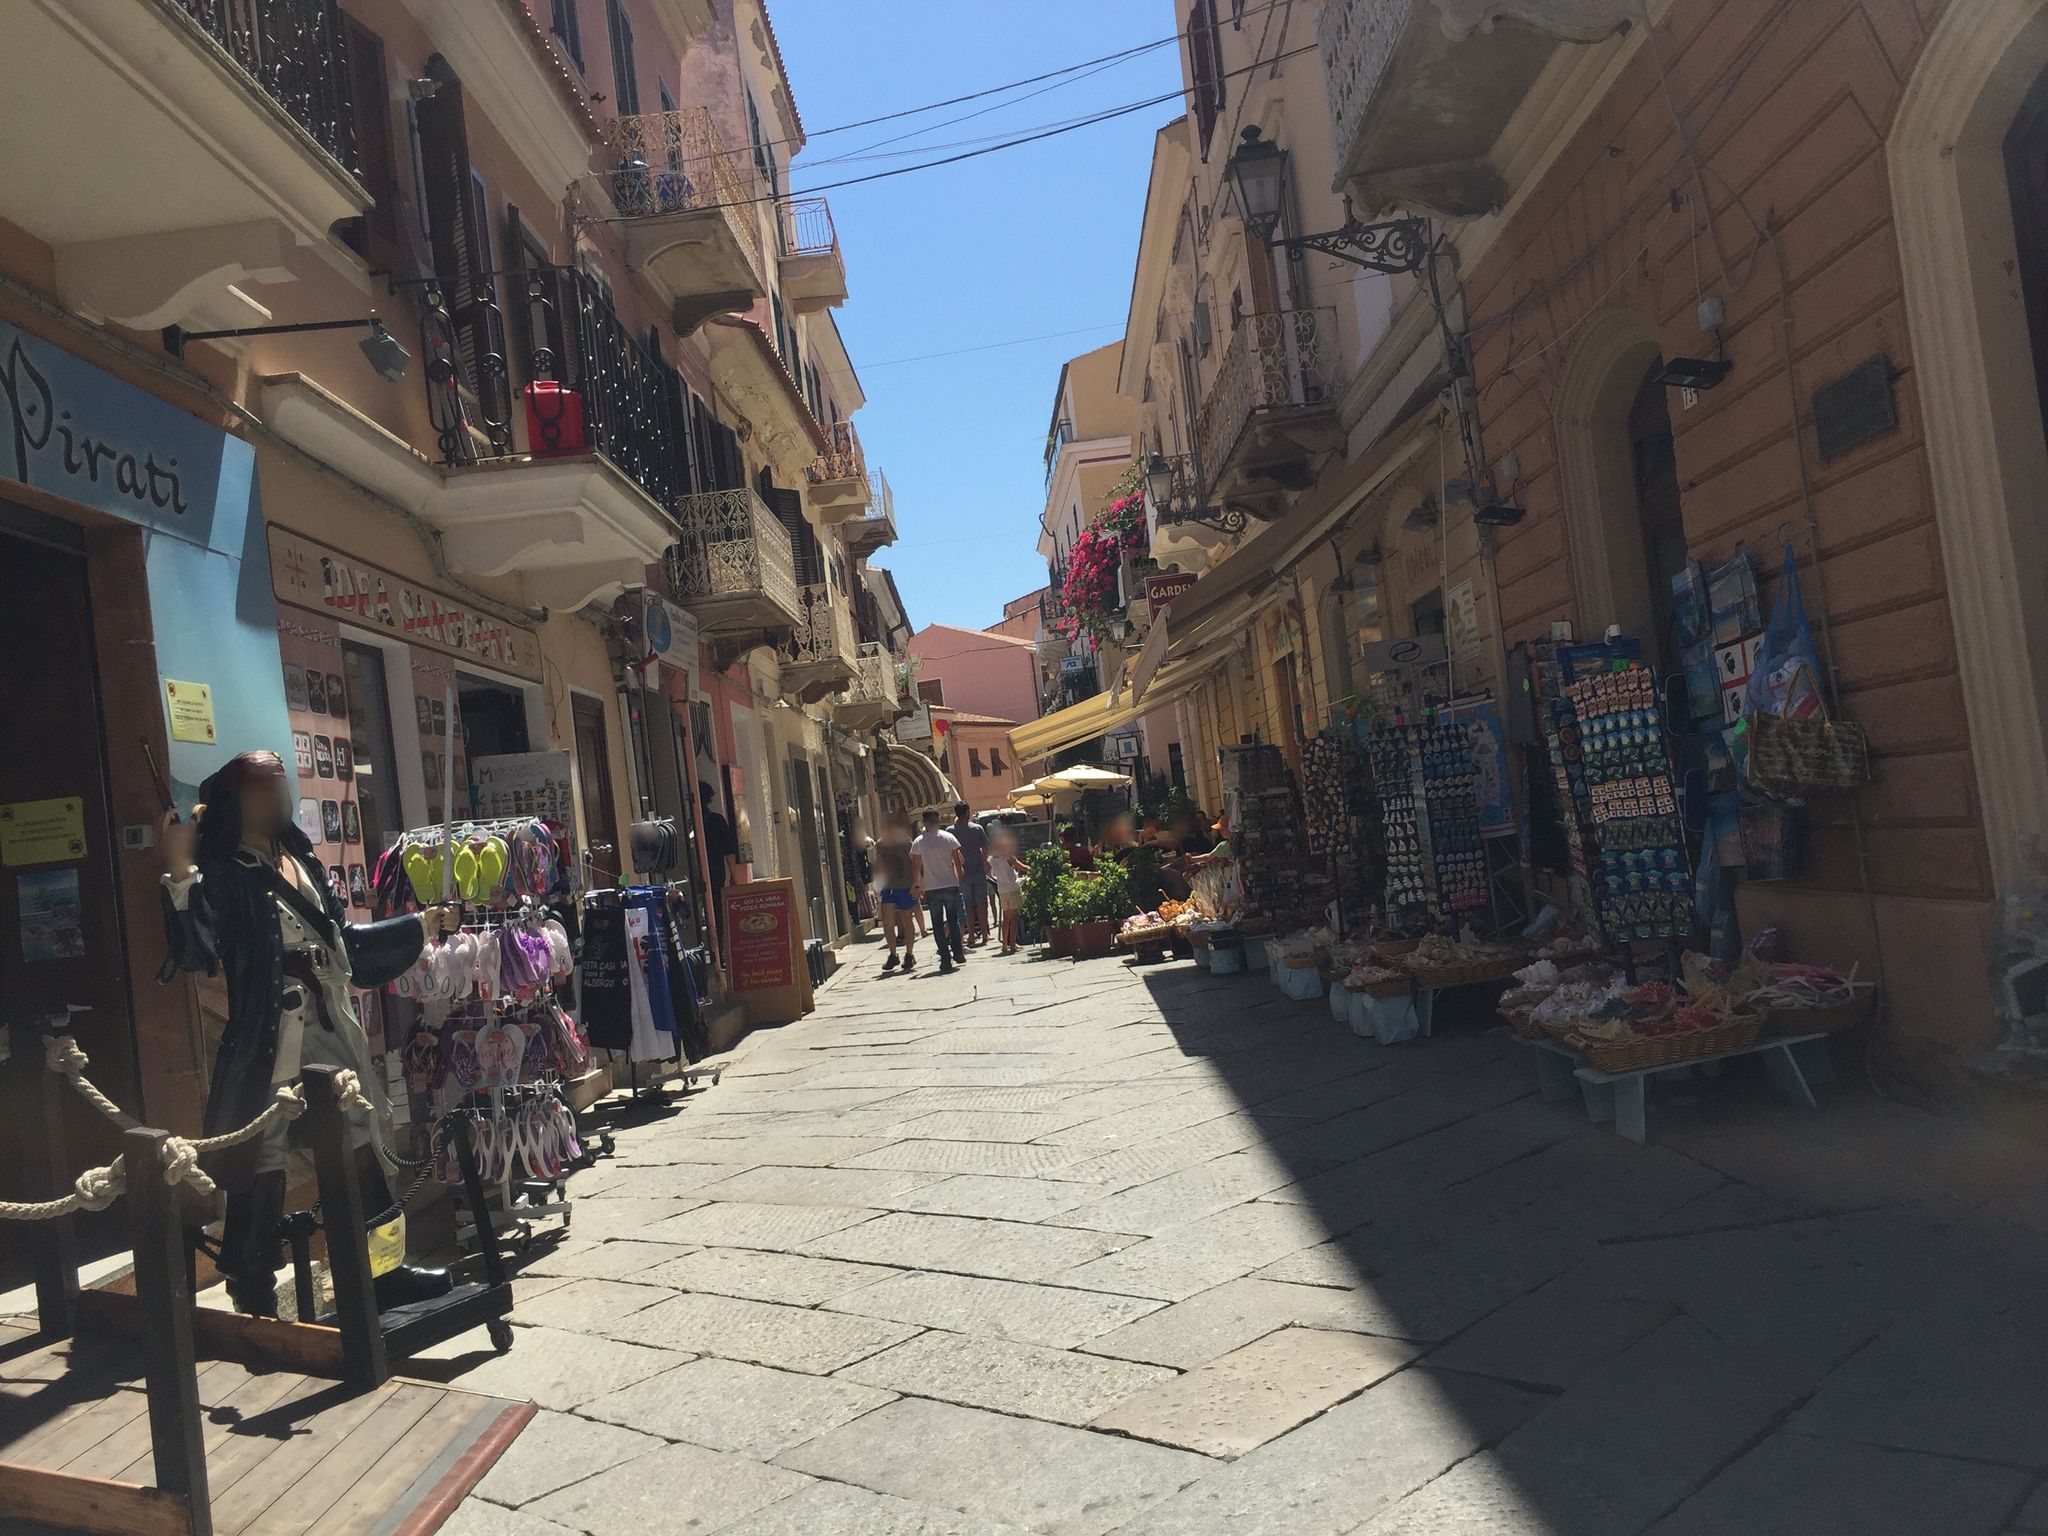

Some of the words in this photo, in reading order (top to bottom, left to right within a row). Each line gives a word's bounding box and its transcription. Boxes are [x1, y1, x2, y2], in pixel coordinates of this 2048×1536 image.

[0, 335, 188, 515] Pirati
[320, 556, 395, 626] IDEA
[399, 586, 518, 668] SARDEGNA
[1151, 583, 1192, 599] GARDE
